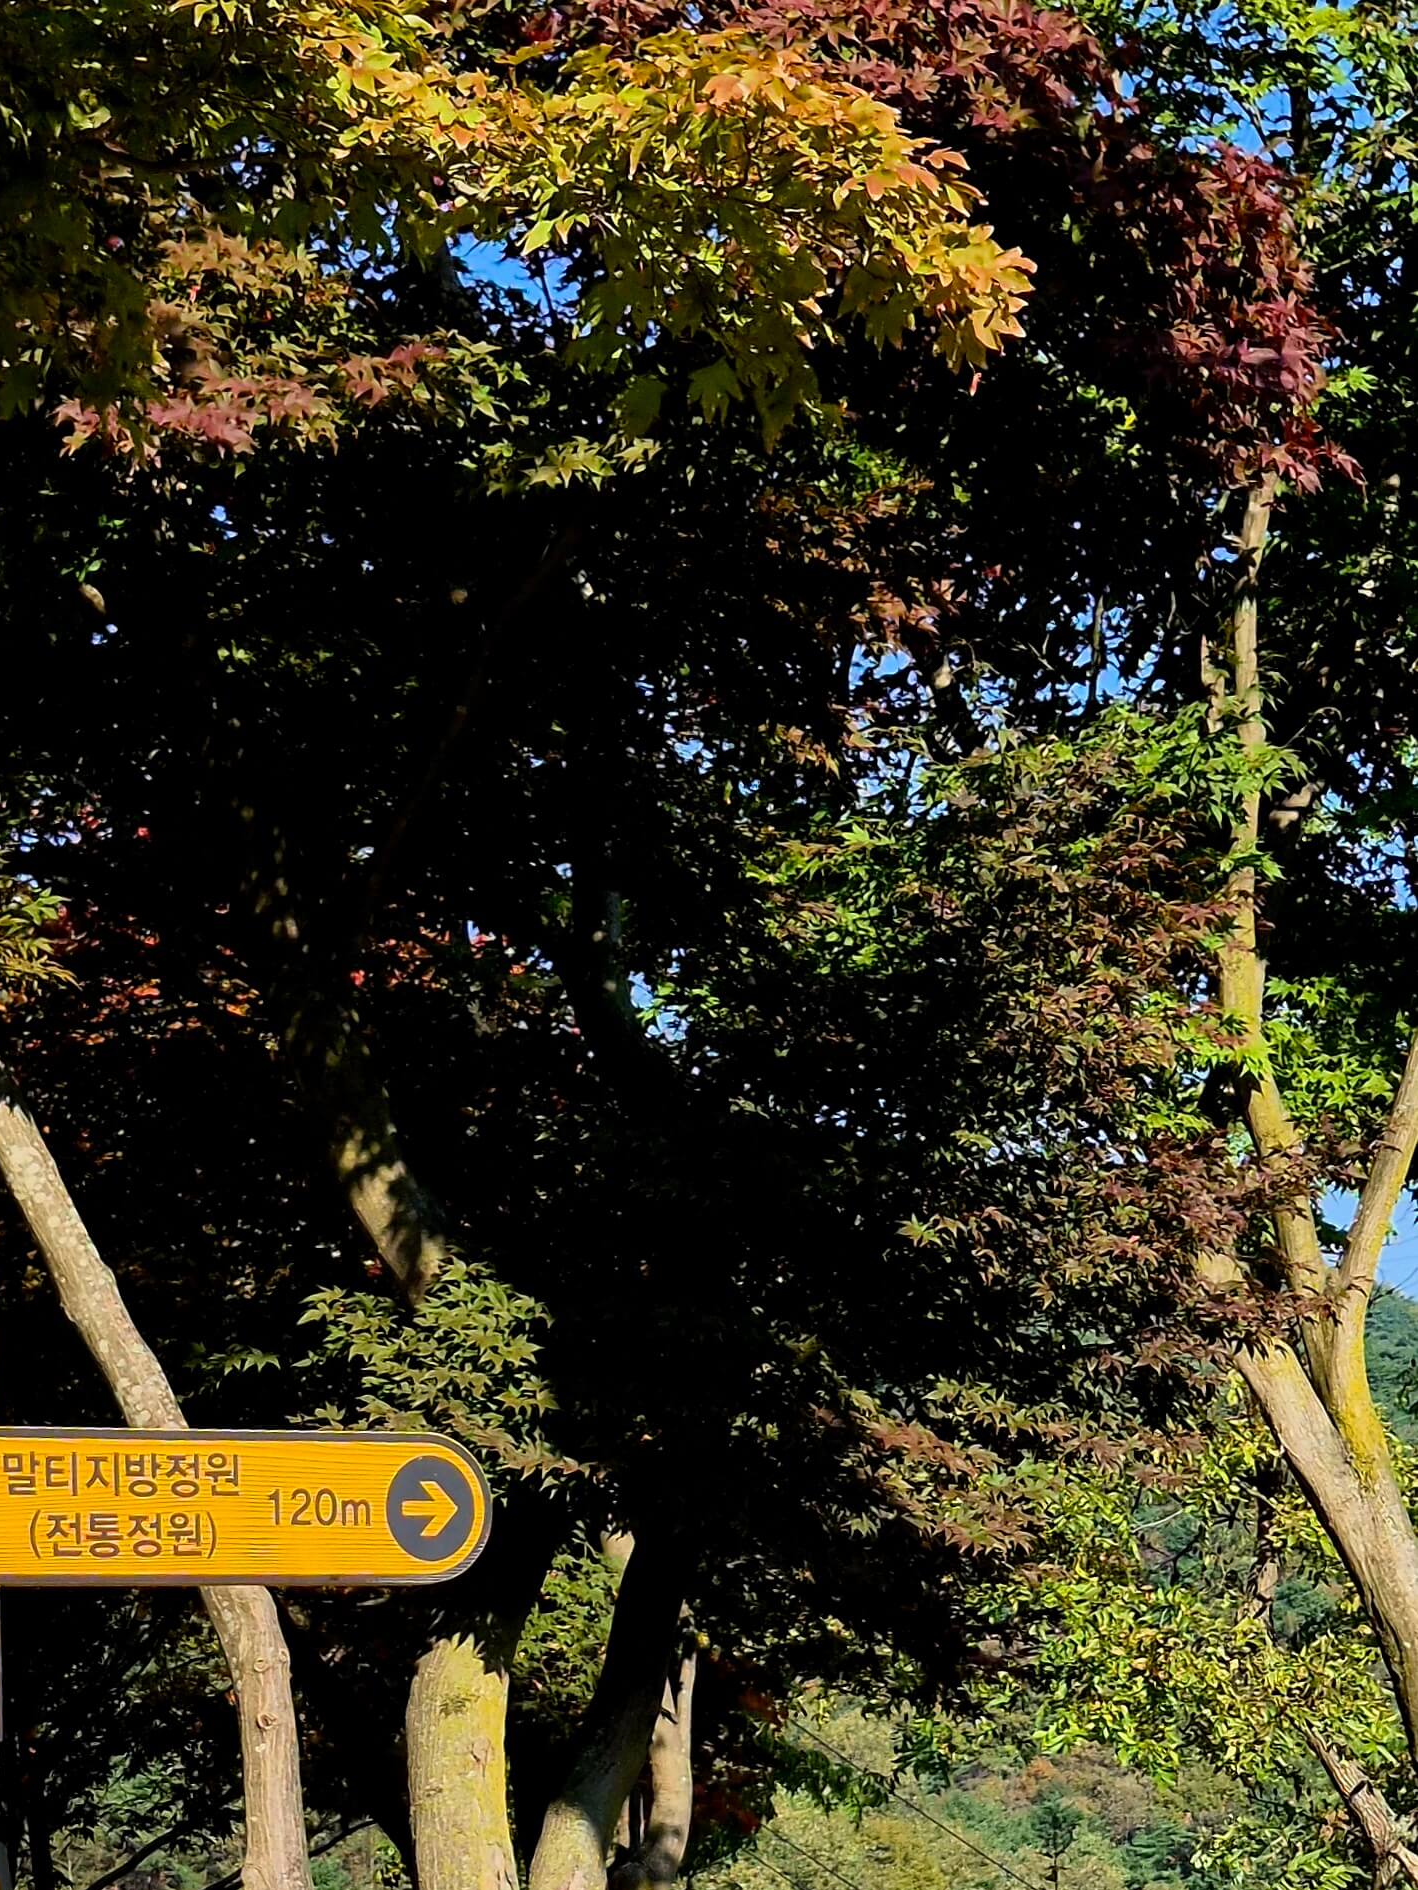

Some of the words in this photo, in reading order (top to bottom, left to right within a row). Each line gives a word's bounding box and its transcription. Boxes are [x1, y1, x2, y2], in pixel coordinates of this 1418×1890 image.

[2, 1451, 240, 1498] 말티지방정원
[266, 1488, 372, 1527] 120m
[29, 1509, 218, 1560] (전통정원)
